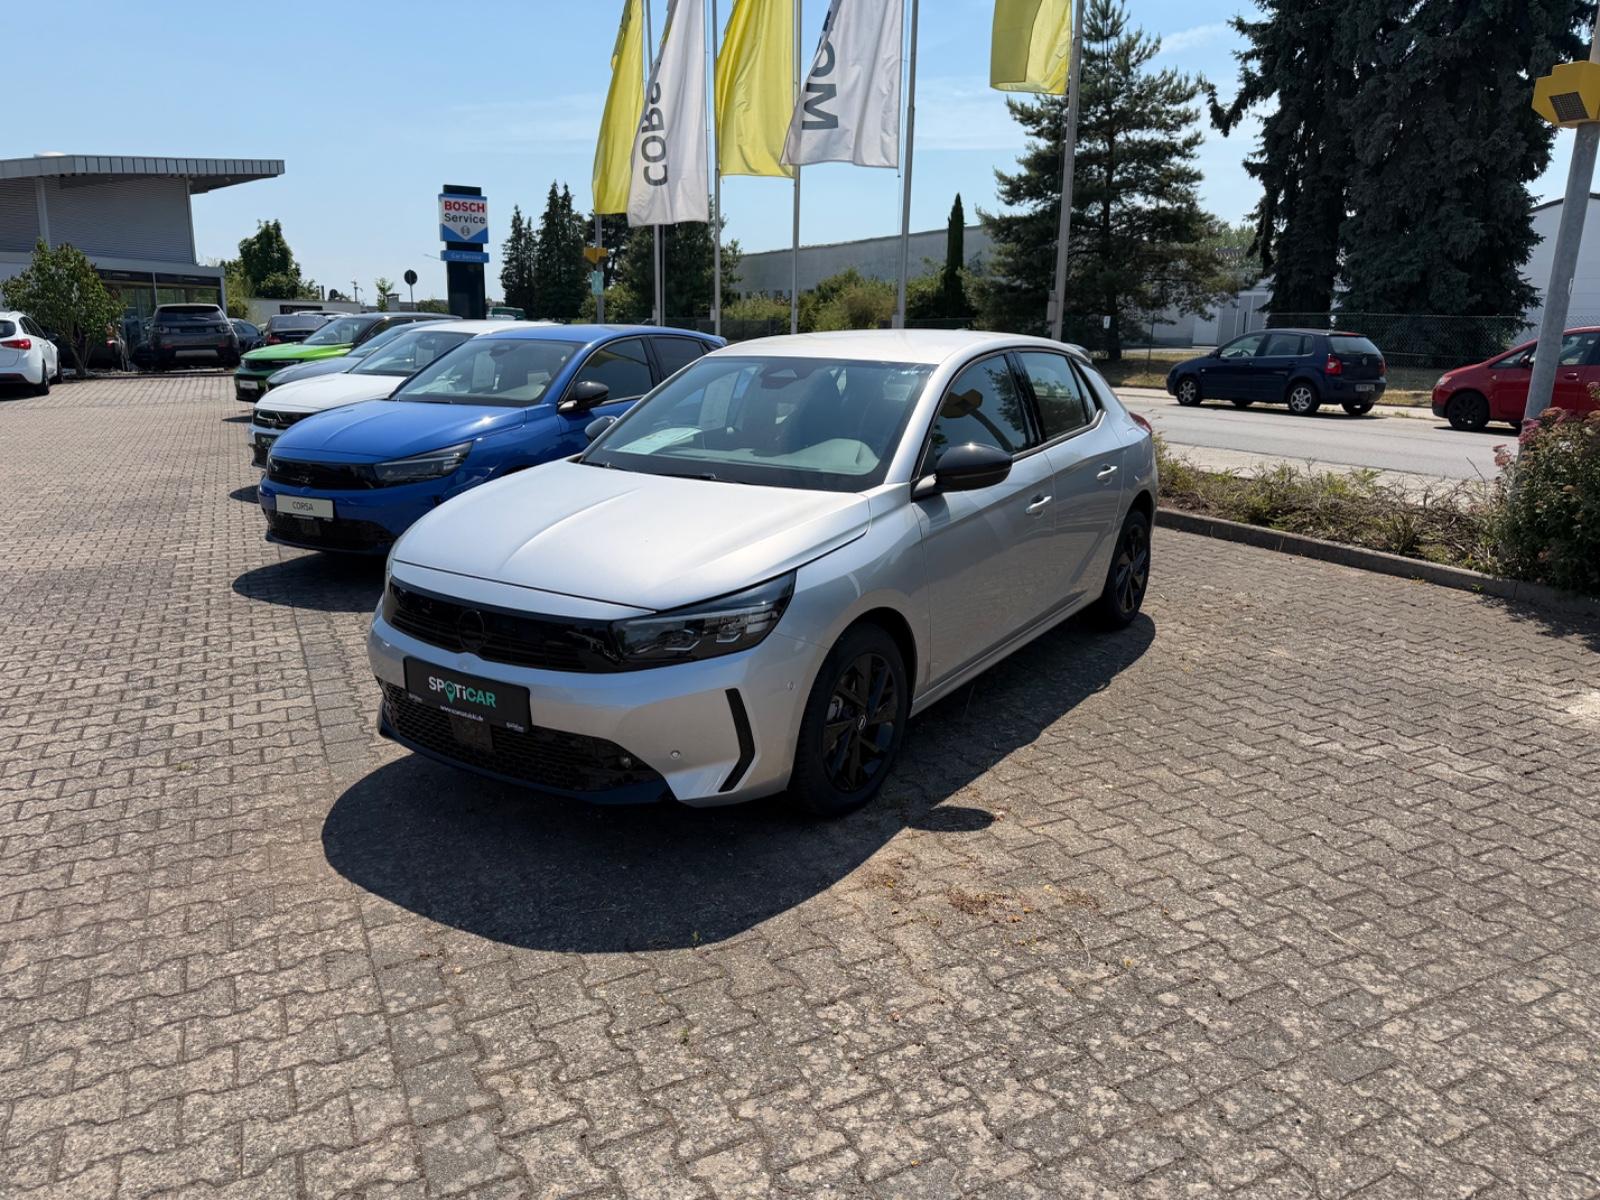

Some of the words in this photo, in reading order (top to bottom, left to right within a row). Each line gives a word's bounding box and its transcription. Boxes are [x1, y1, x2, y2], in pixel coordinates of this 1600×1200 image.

[444, 200, 486, 213] BOSCH
[444, 213, 486, 224] Service
[292, 501, 314, 512] CORSA
